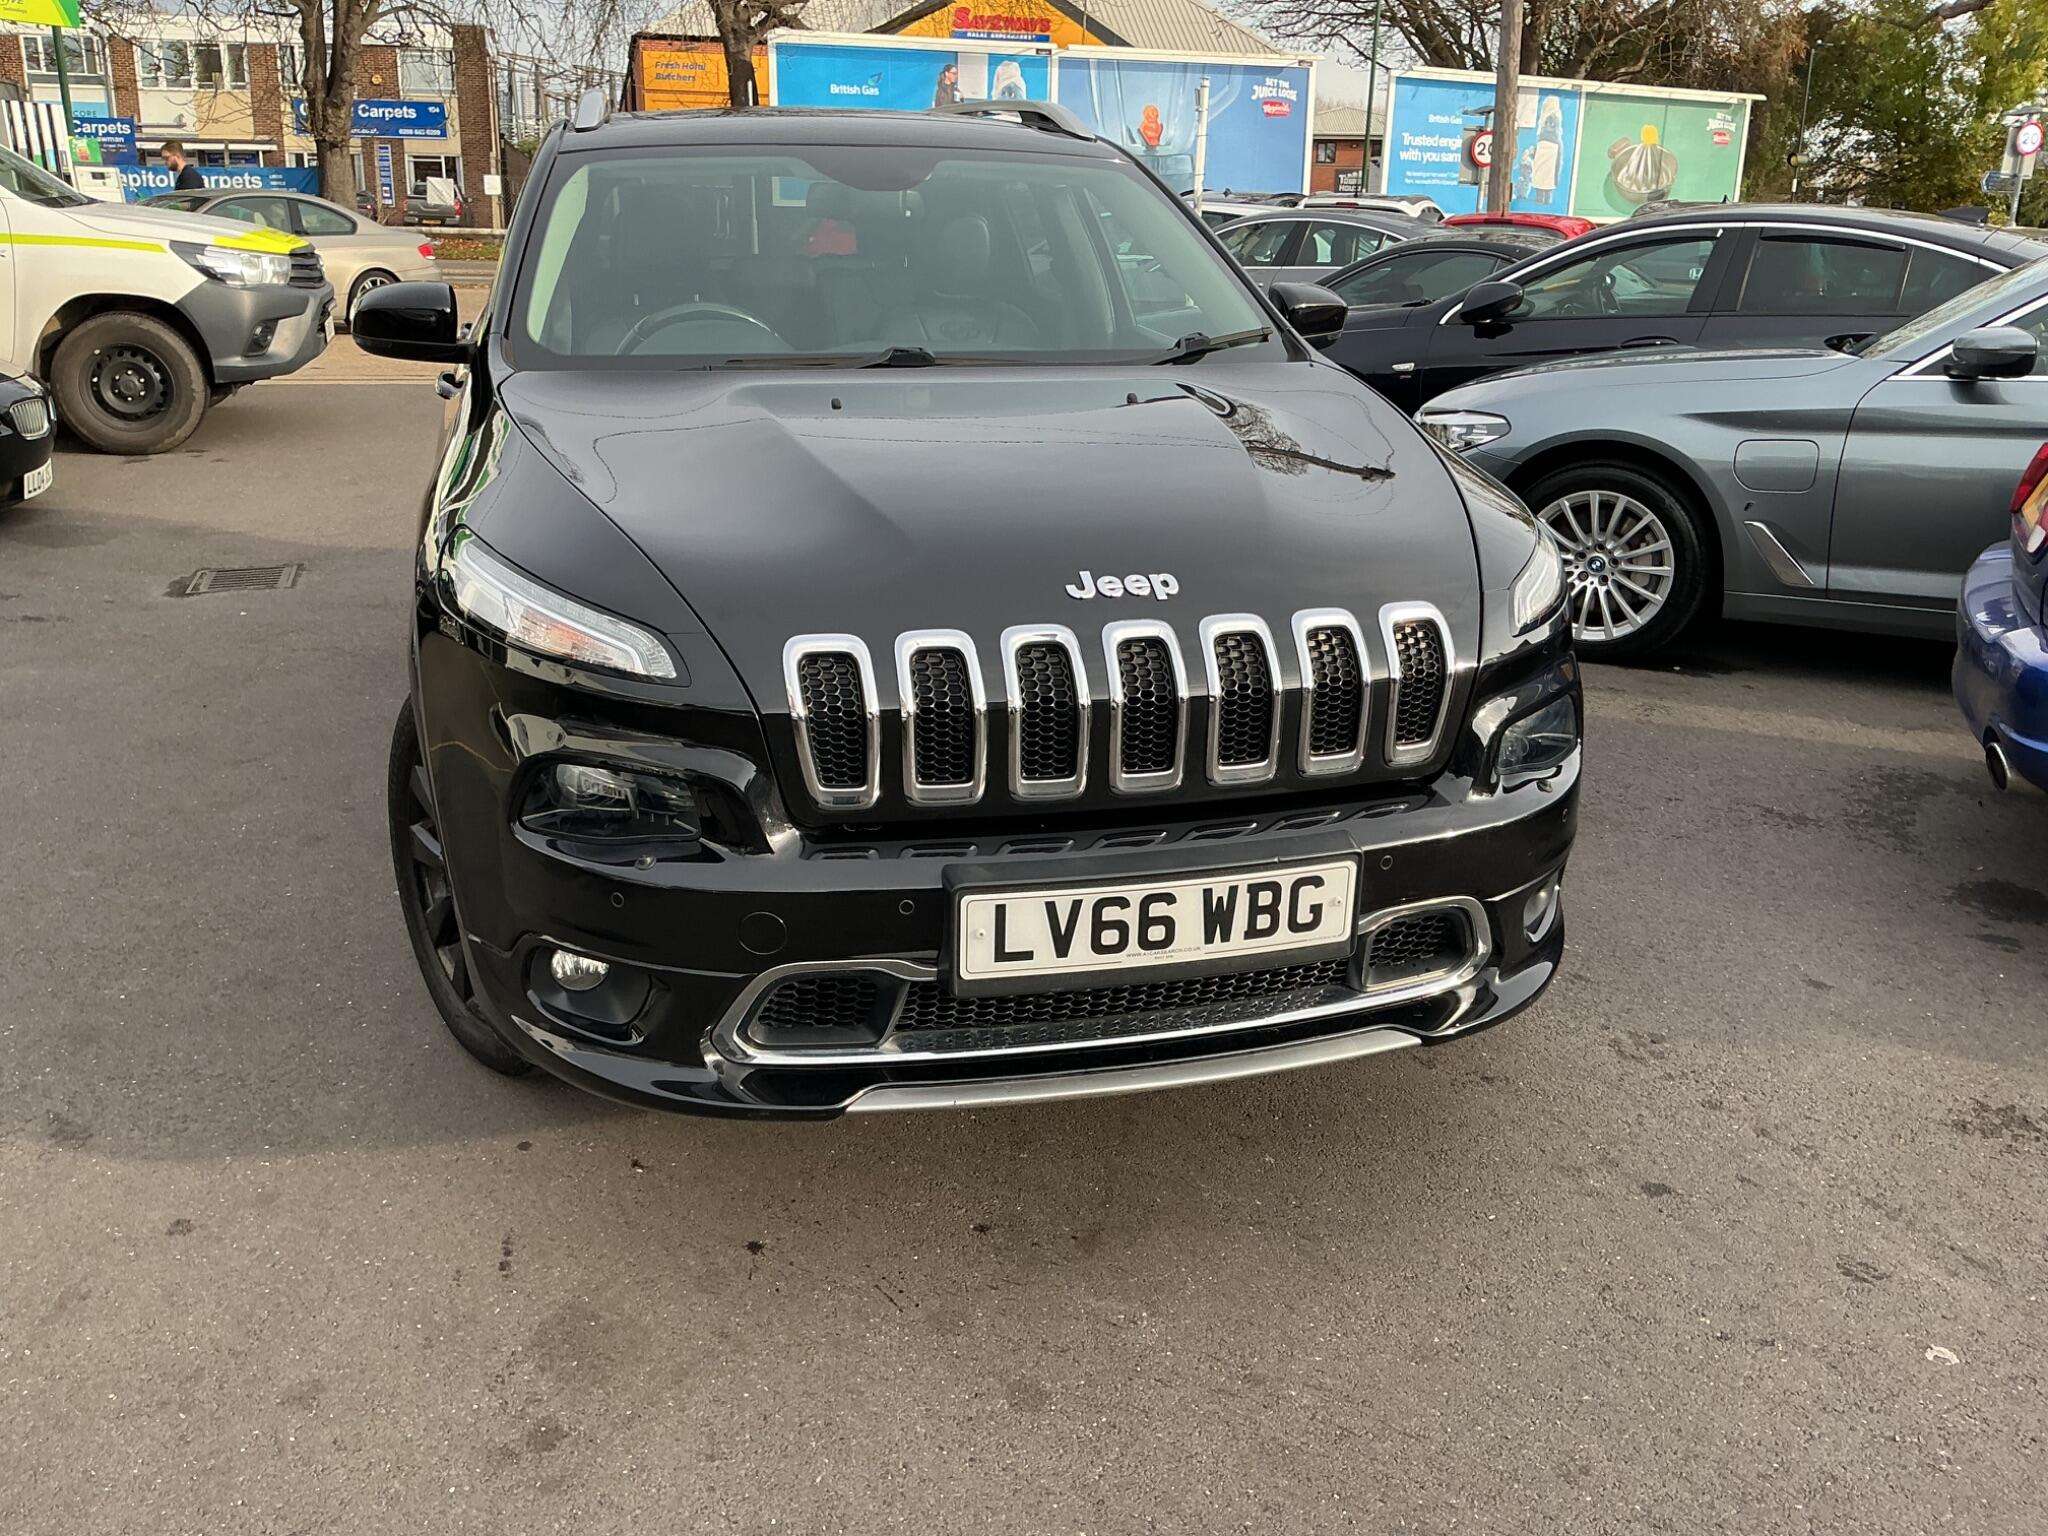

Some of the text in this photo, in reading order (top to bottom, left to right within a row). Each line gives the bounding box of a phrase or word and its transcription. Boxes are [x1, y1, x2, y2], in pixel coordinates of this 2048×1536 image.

[830, 84, 880, 96] British Gas
[1251, 85, 1277, 100] JUICE
[358, 103, 417, 121] Carpets
[1402, 133, 1462, 149] Trusted engi
[2022, 132, 2039, 145] 20
[1400, 149, 1461, 163] with you sam
[1065, 570, 1179, 600] Jeep
[994, 875, 1325, 963] LV66 WBG
